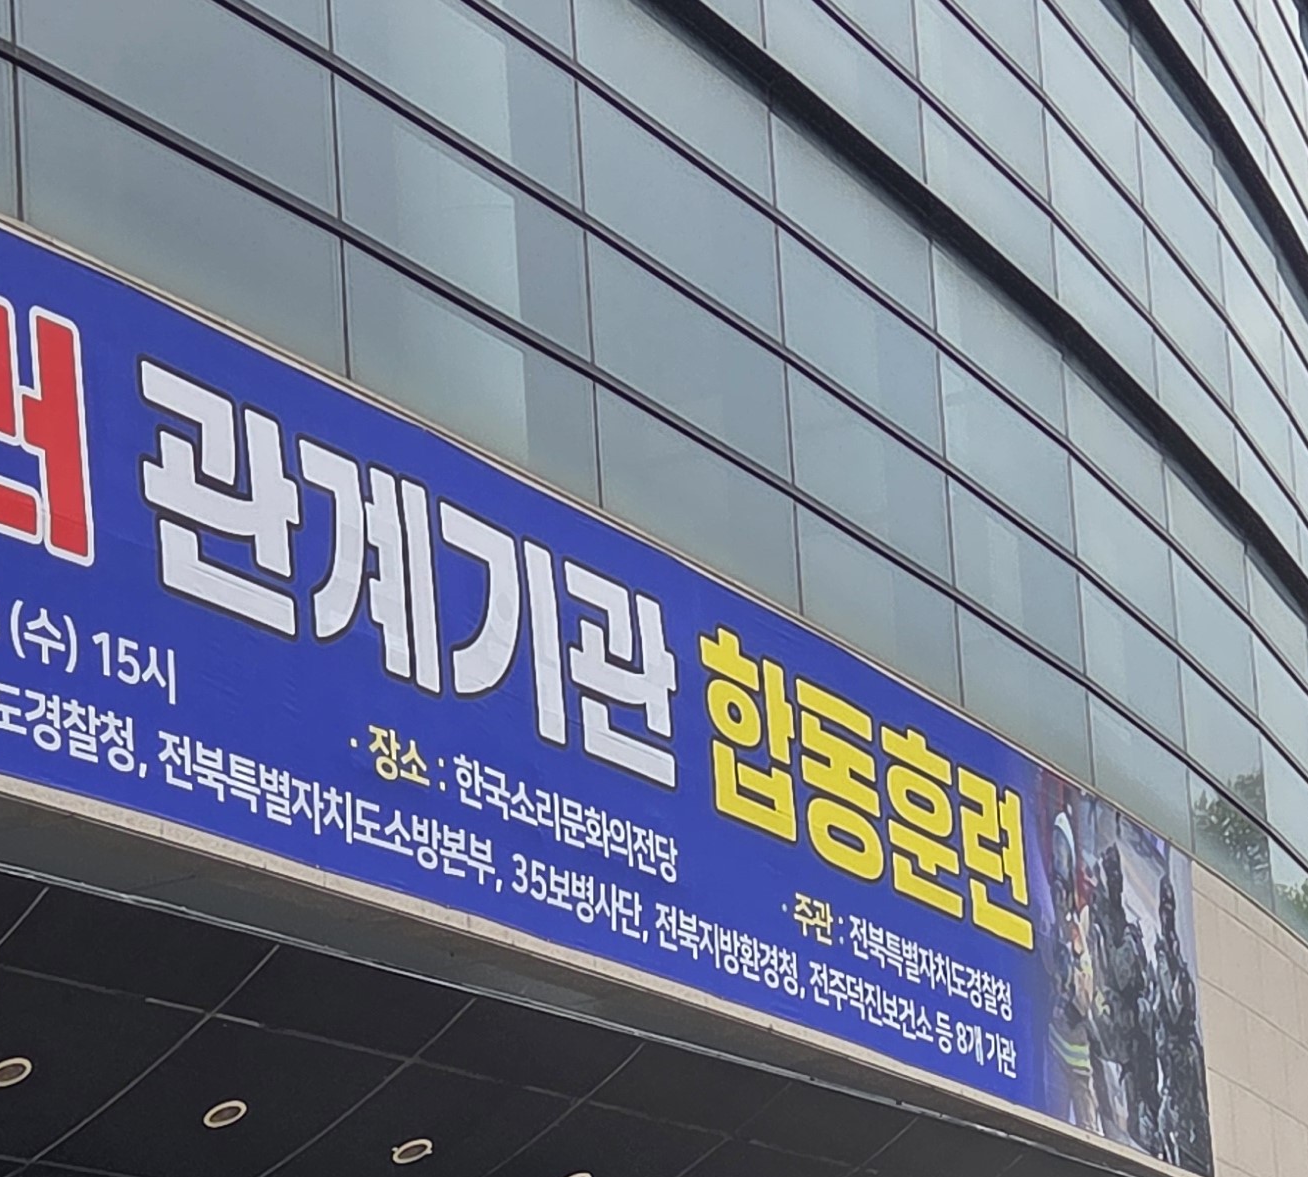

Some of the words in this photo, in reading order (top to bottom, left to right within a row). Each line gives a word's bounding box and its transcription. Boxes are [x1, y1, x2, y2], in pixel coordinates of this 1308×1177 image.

[92, 631, 177, 705] 15시
[140, 359, 677, 788] 관계기관
[699, 627, 1033, 950] 합동훈련
[368, 724, 430, 787] 장소
[453, 754, 678, 883] 한국소리문화의전당
[157, 728, 503, 893] 전북특별자치도소방본부,
[511, 853, 649, 944] 35보병사단,
[655, 902, 806, 999] 전북지방환경청,
[809, 960, 934, 1042] 전주덕진보건소
[935, 1011, 954, 1054] 등
[956, 1022, 984, 1065] 8개
[986, 1031, 1018, 1079] 기관
[793, 892, 833, 945] 주관
[849, 915, 1013, 1022] 전북특별자치도경찰청
